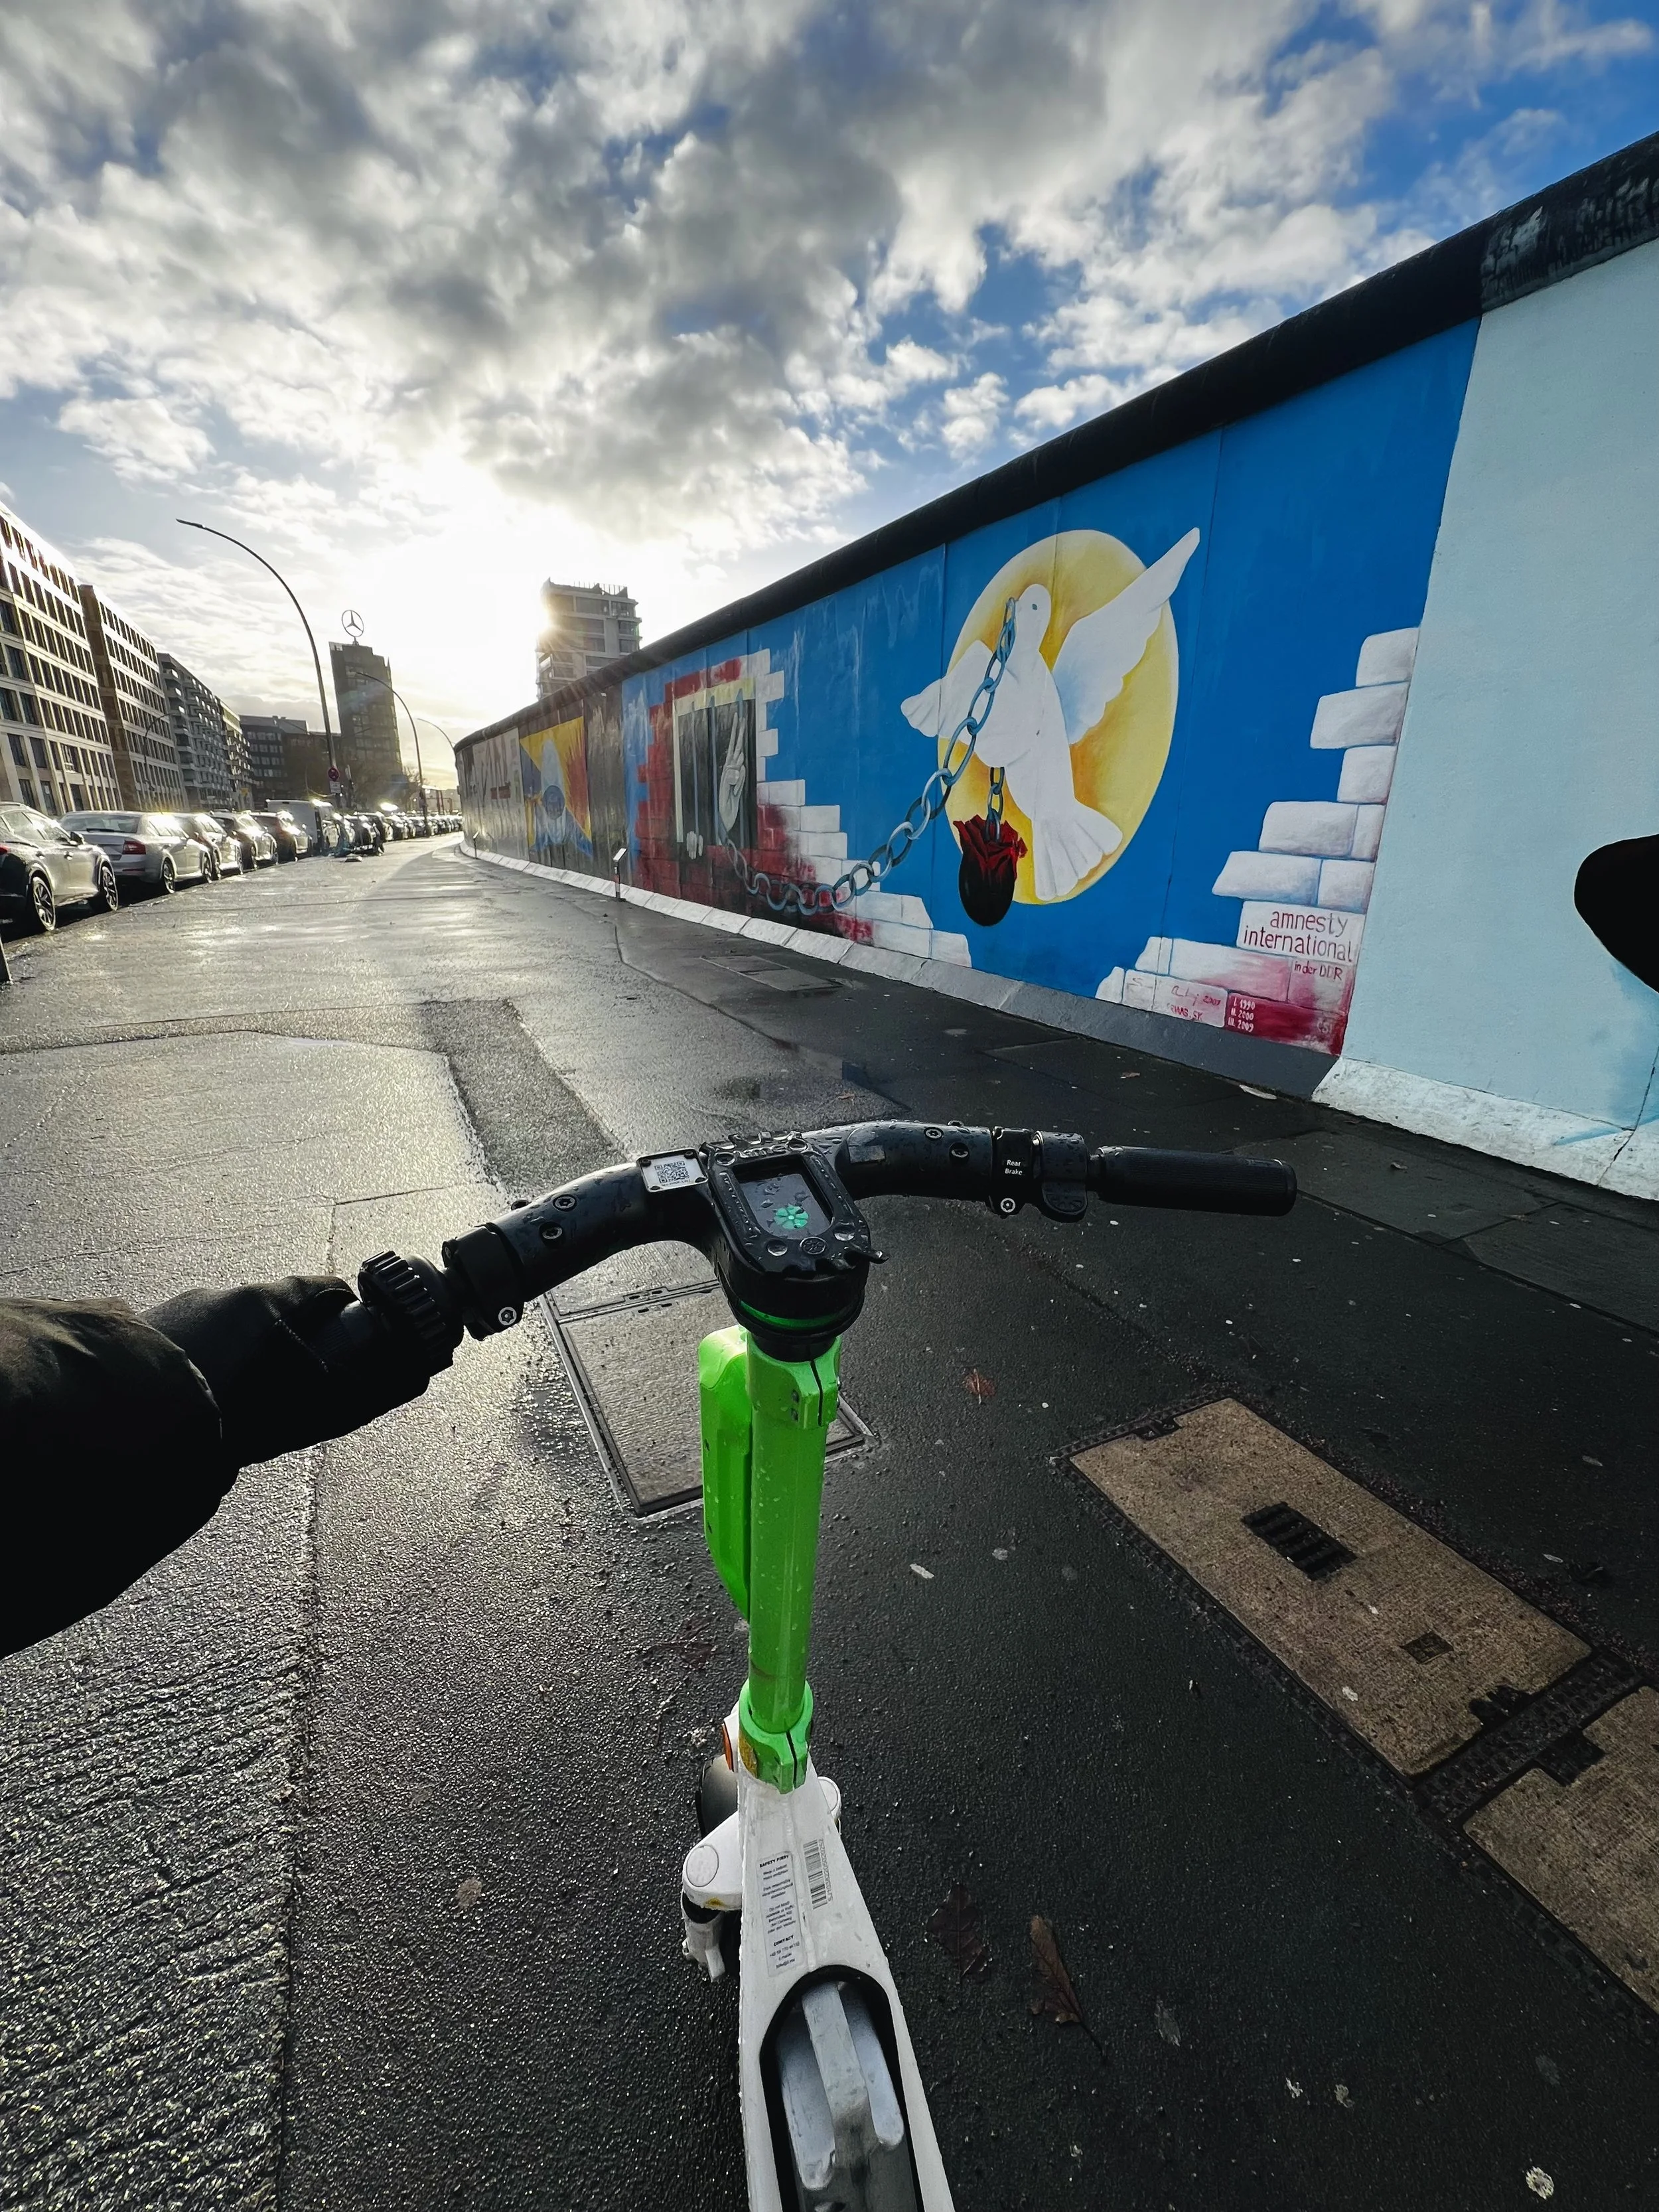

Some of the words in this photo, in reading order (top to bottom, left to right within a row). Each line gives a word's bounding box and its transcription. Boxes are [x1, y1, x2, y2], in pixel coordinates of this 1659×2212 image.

[1270, 911, 1348, 937] amnesty
[1244, 926, 1352, 962] international
[1294, 961, 1301, 972] in
[1302, 960, 1317, 974] der
[1240, 998, 1256, 1010] 1990
[1238, 1009, 1254, 1021] 2000
[1237, 1019, 1254, 1033] 2009
